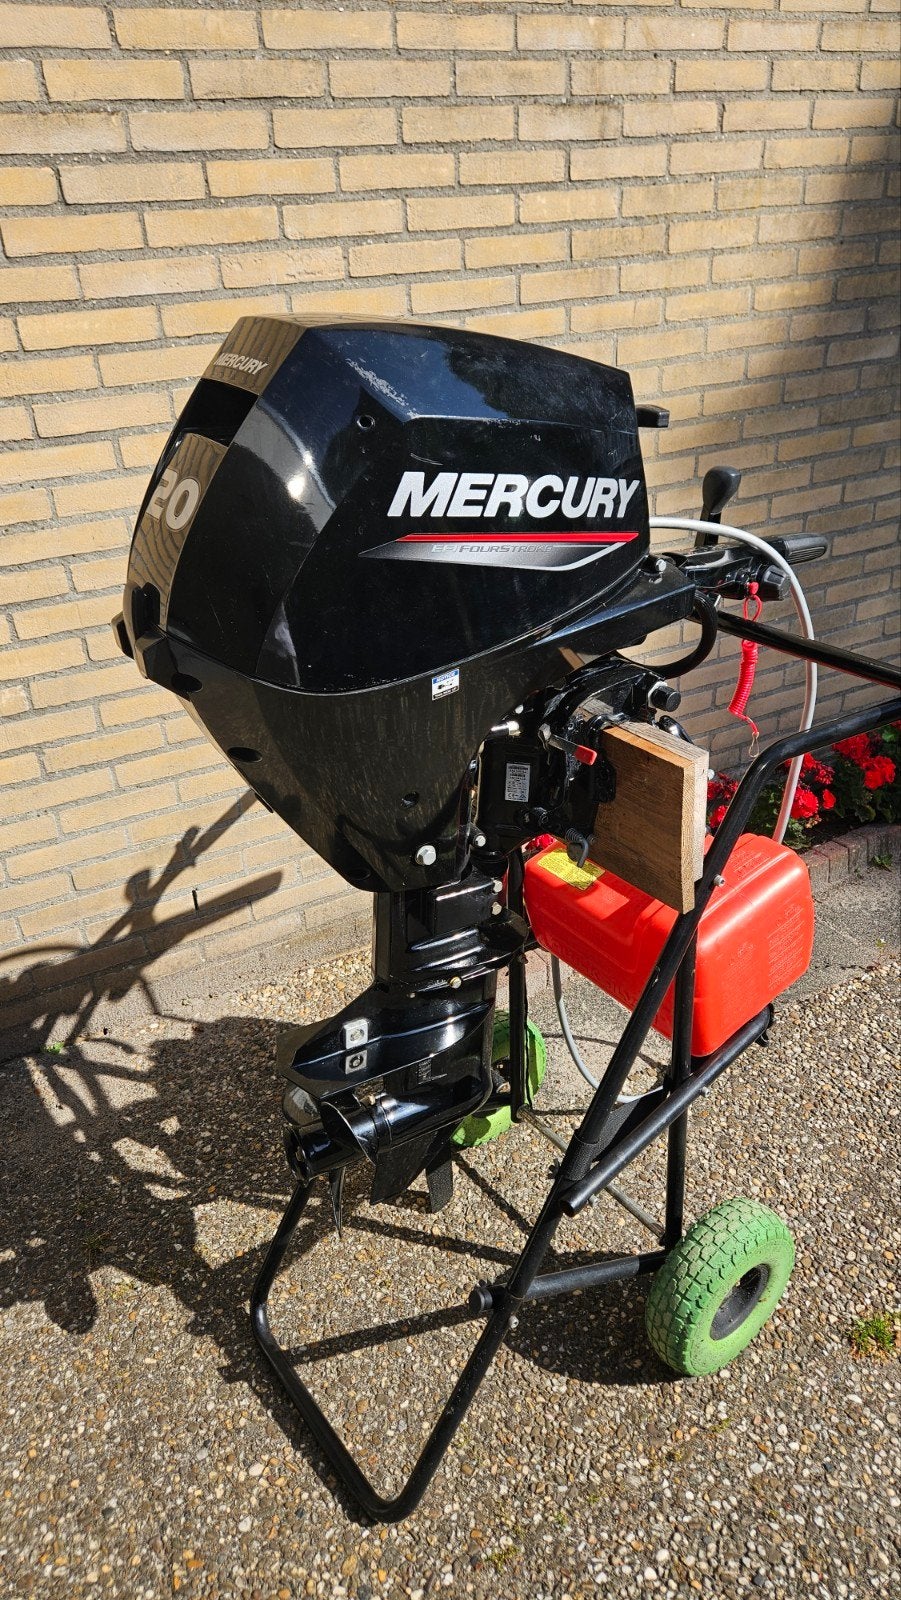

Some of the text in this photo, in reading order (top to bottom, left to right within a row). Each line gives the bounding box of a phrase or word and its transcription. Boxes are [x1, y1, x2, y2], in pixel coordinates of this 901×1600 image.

[214, 353, 269, 375] MERCURY
[146, 468, 200, 530] 20
[387, 471, 640, 518] MERCURY
